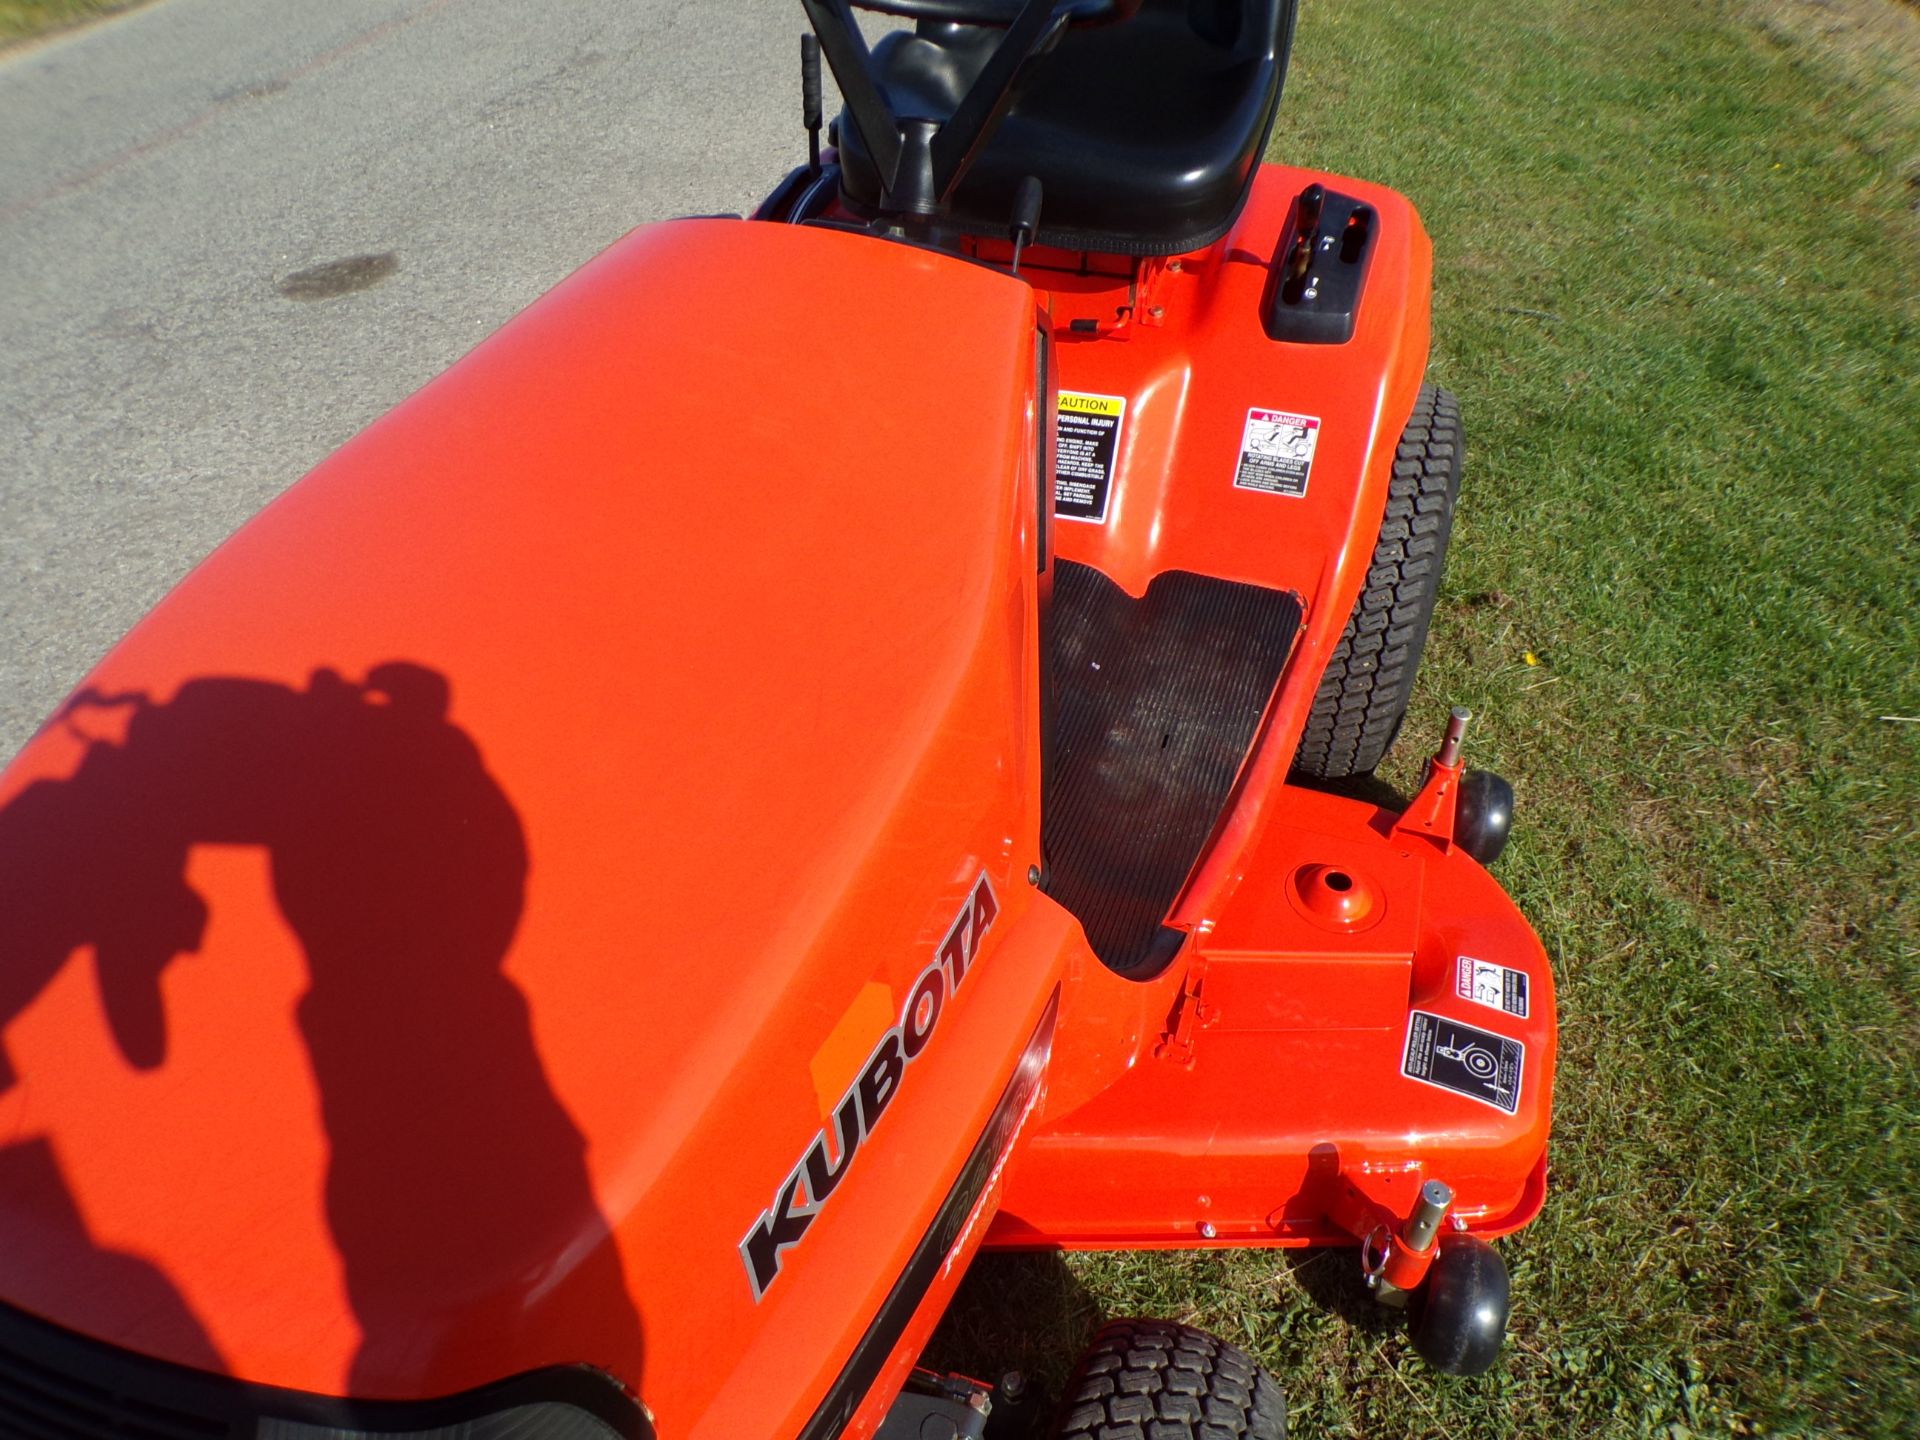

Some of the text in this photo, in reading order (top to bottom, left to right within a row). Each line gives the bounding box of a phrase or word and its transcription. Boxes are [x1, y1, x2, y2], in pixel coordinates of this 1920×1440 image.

[1058, 414, 1114, 428] PERSONAL INJURY
[1271, 414, 1306, 427] DANGER
[1074, 428, 1098, 436] FUNCTION
[1461, 959, 1472, 990] DANGER
[739, 869, 1000, 1304] KUBOTA
